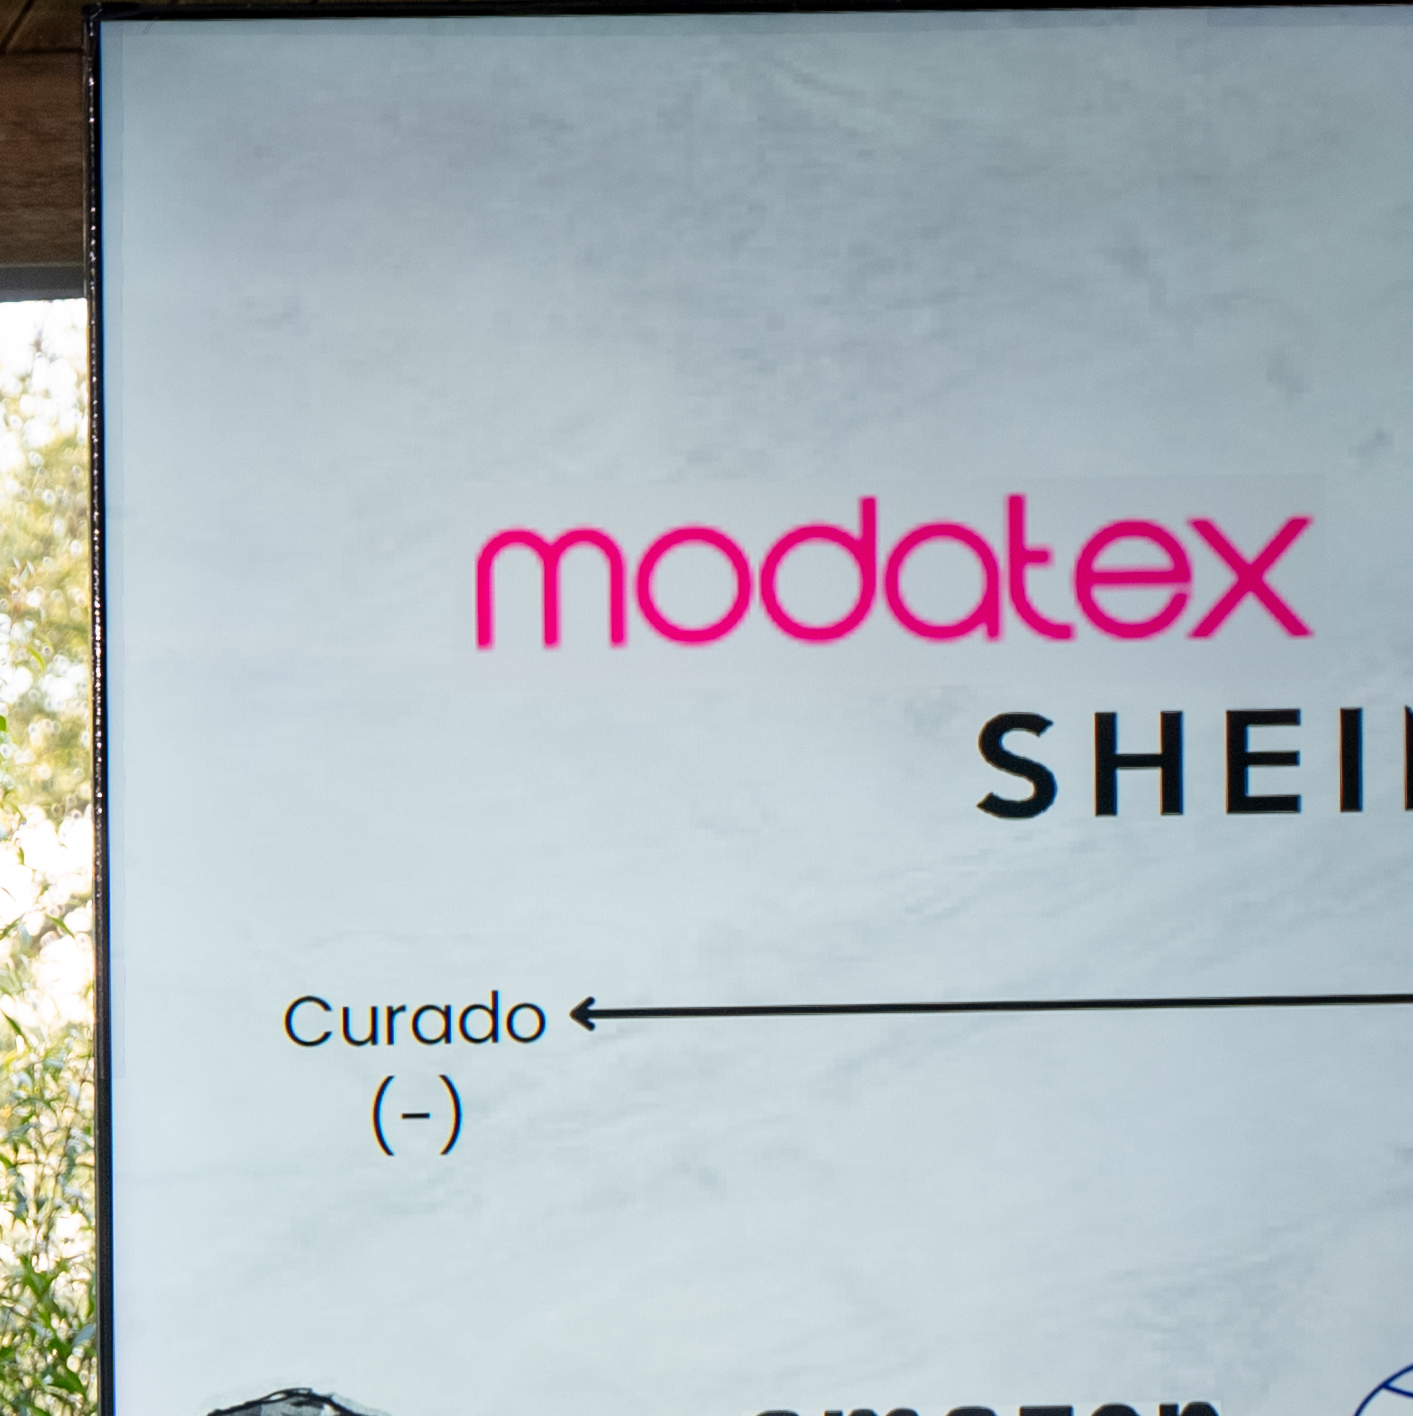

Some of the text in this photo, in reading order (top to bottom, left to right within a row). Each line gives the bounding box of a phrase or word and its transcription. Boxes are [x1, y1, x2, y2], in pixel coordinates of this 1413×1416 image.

[475, 494, 1315, 650] modatex
[976, 704, 1413, 819] SHEI
[284, 989, 546, 1047] Curado
[372, 1074, 463, 1156] (-)
